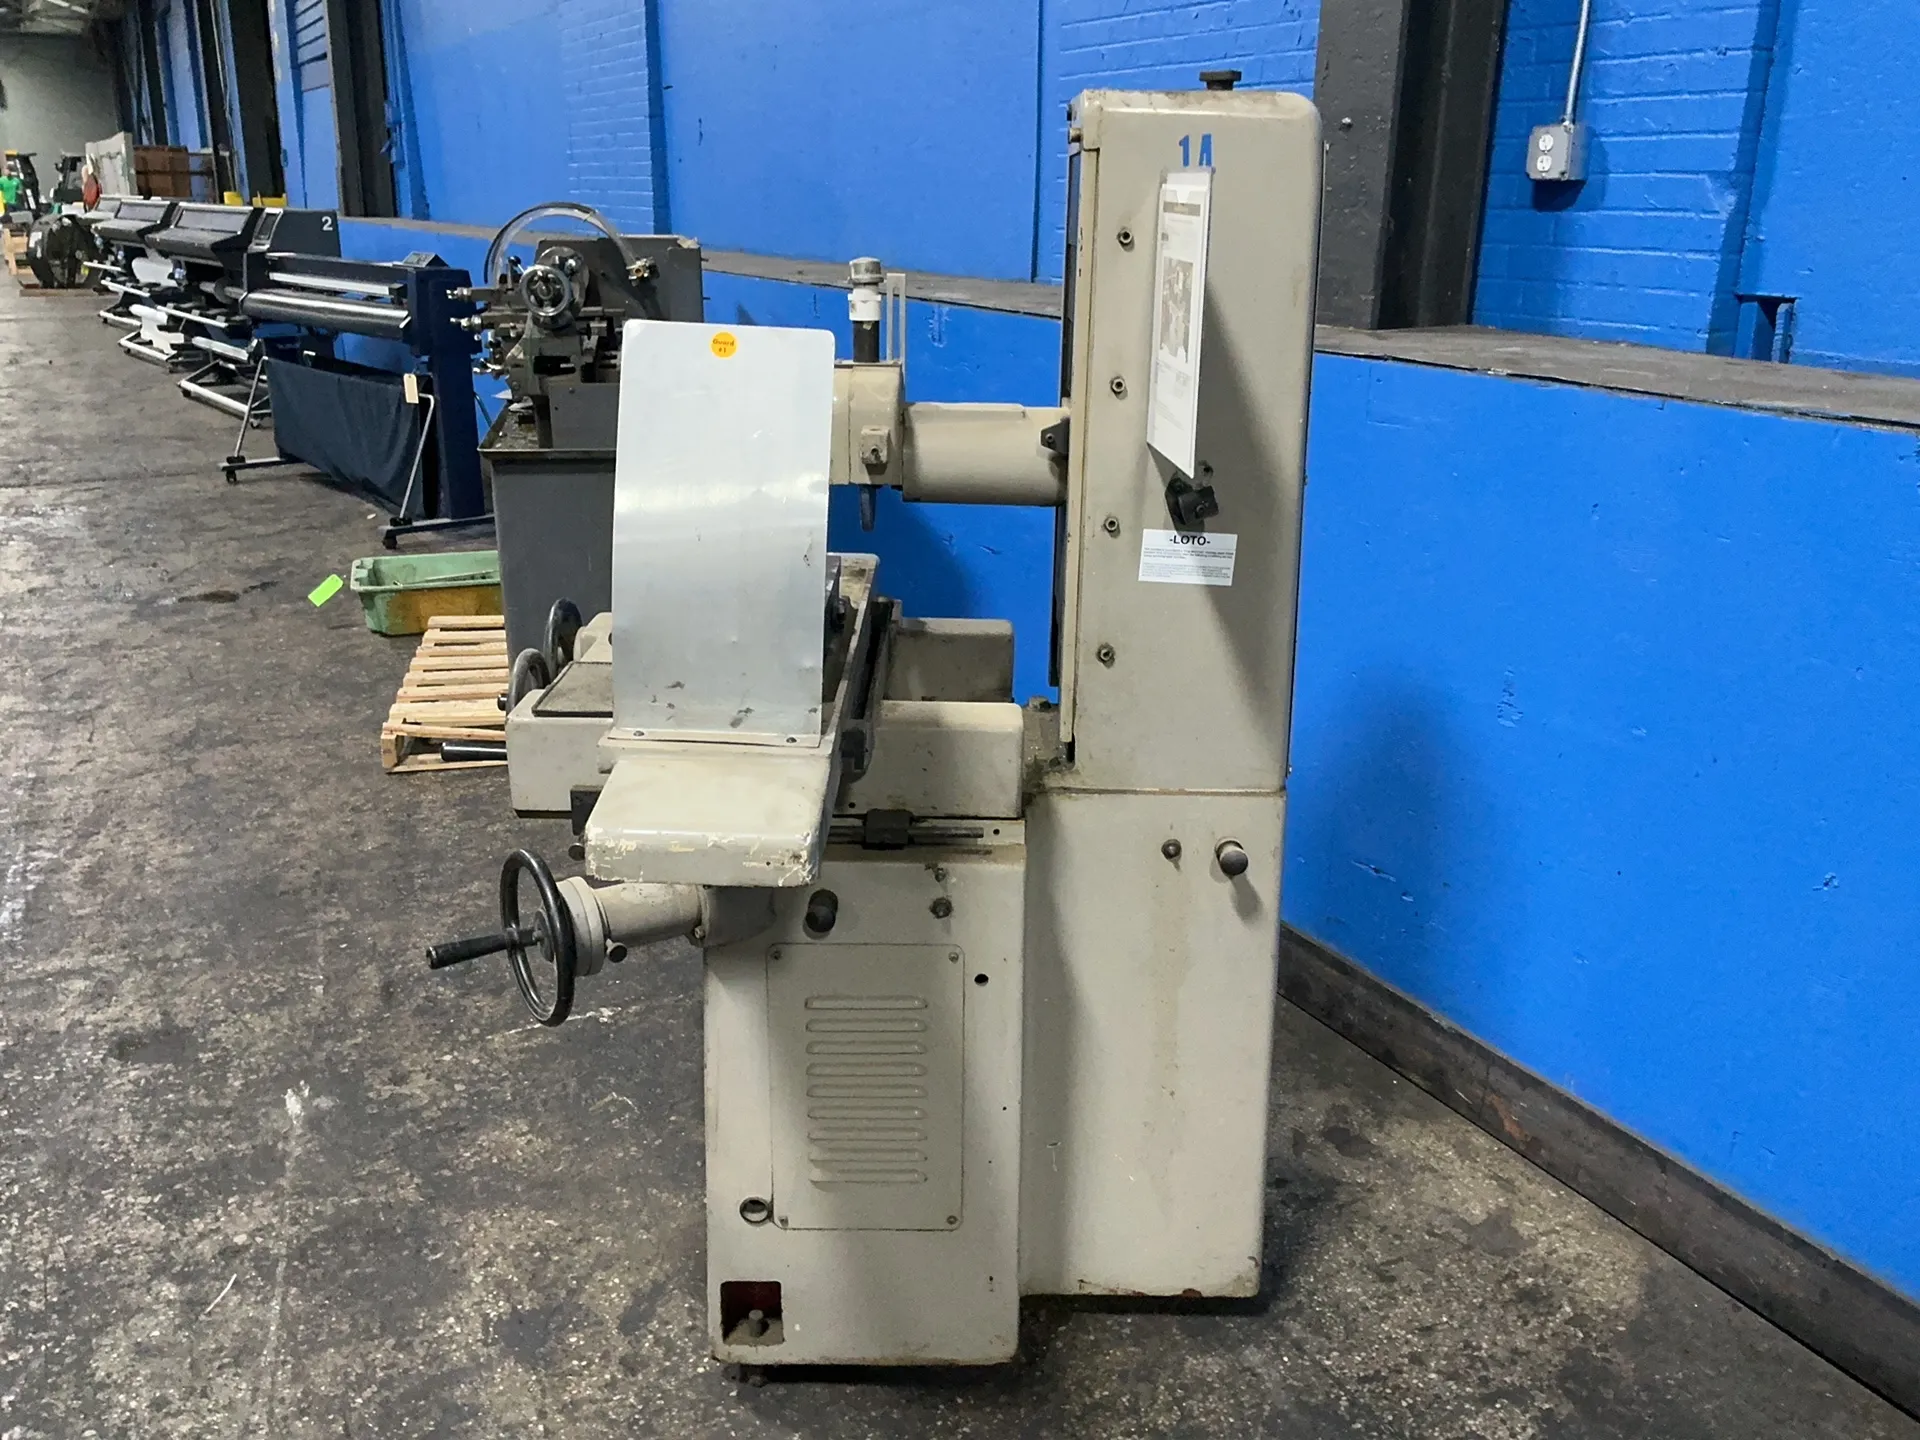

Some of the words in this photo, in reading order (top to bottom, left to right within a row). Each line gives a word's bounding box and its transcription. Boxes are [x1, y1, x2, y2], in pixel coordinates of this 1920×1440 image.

[321, 216, 333, 231] 2
[712, 338, 735, 347] Guard
[1169, 535, 1211, 546] -LOTO-
